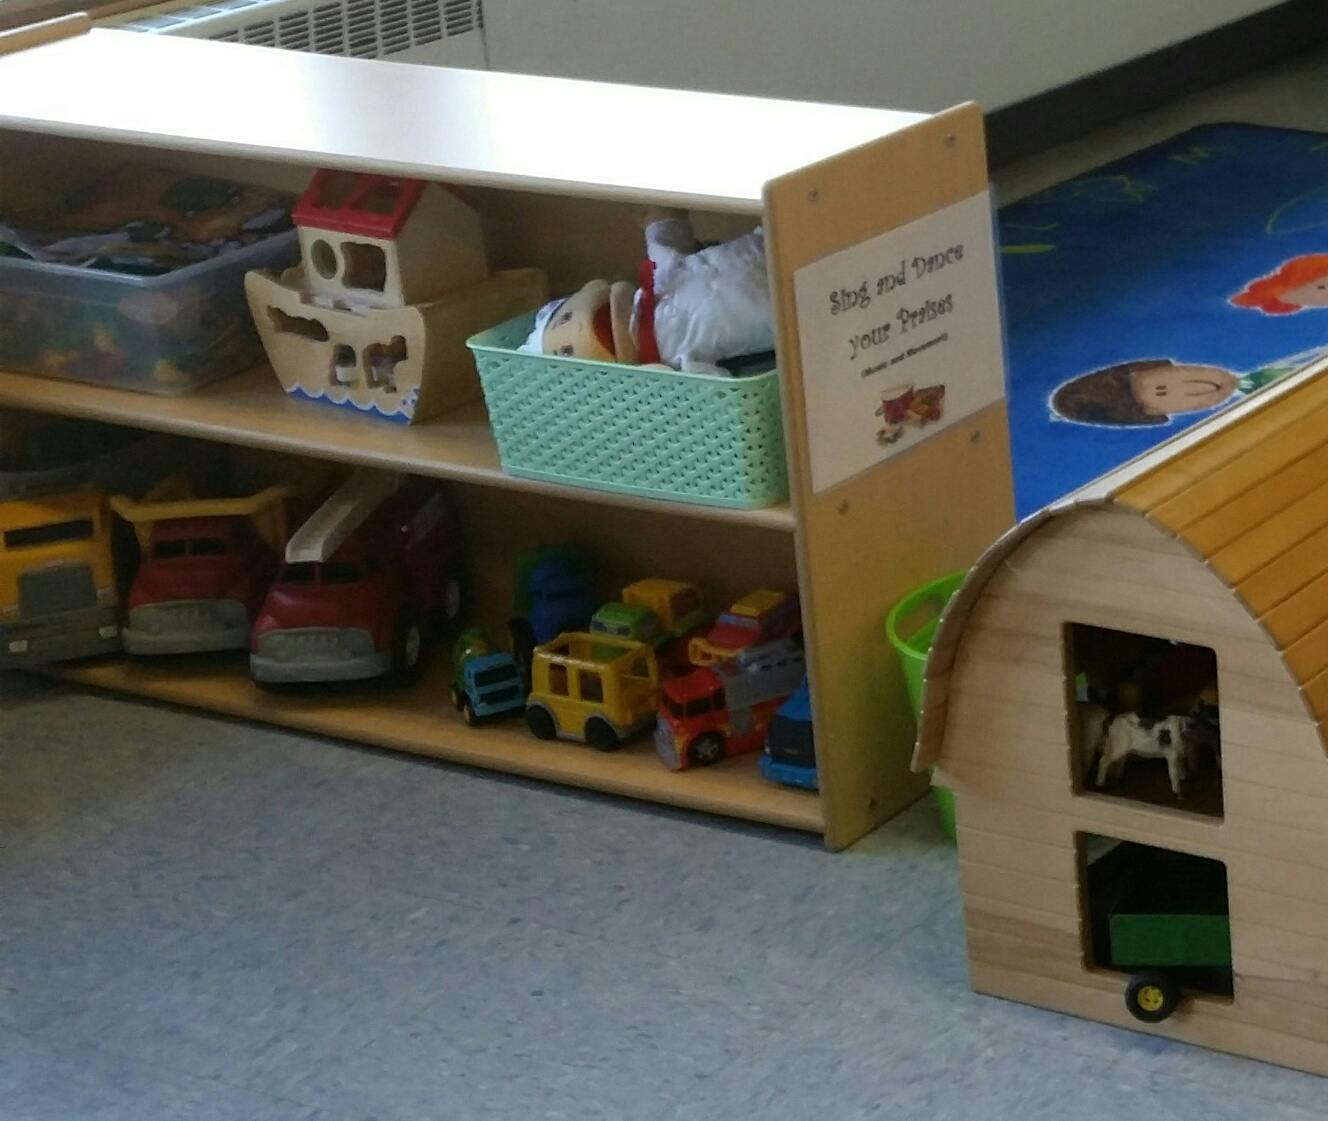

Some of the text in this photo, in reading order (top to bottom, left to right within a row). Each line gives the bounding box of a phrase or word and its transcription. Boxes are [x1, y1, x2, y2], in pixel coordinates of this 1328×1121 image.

[829, 243, 965, 316] Sing and Dance
[895, 293, 955, 334] Praises
